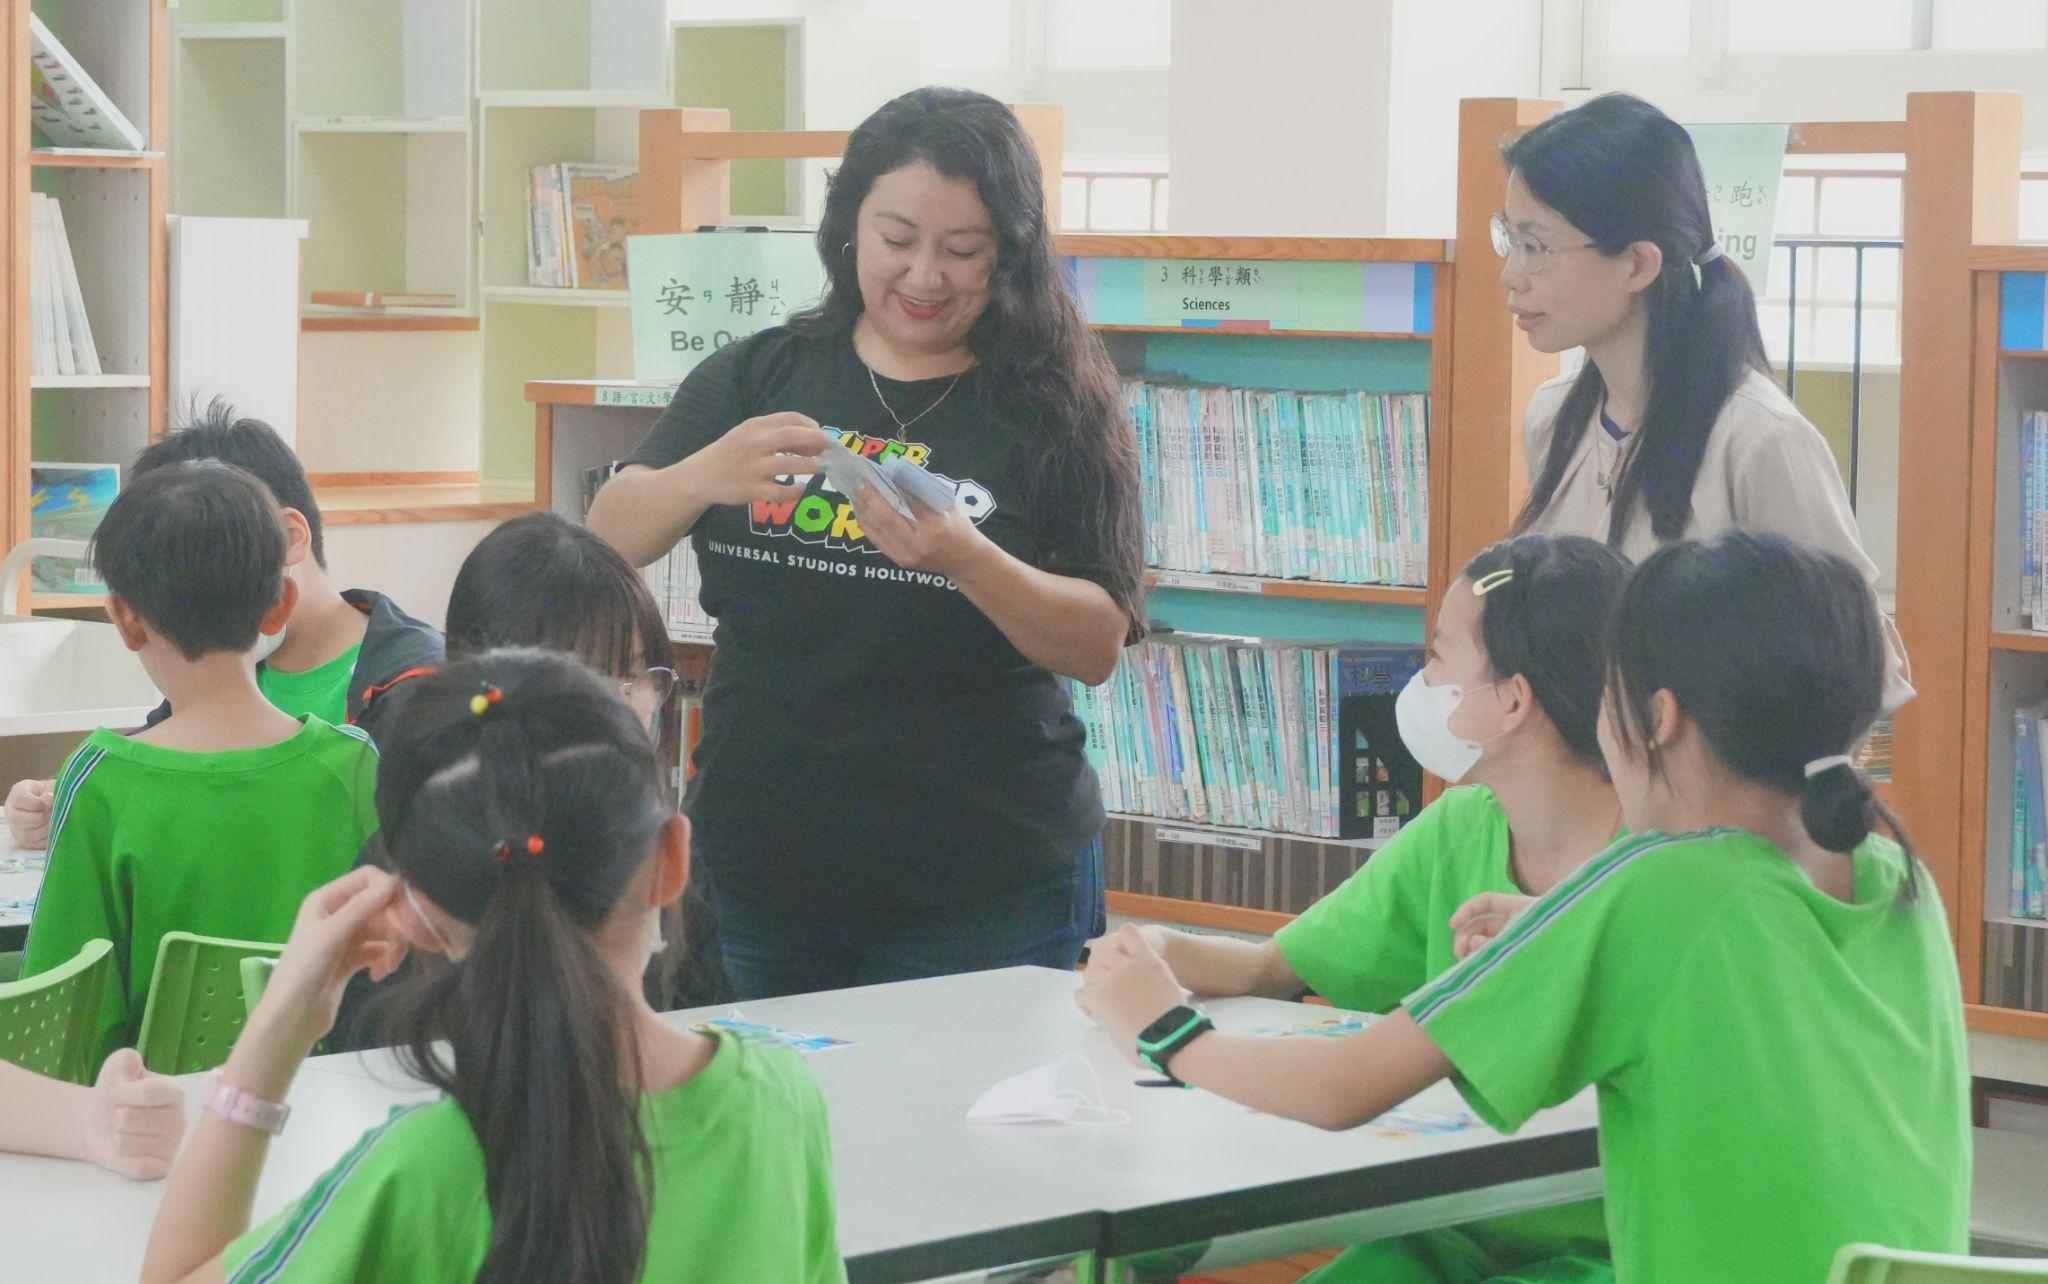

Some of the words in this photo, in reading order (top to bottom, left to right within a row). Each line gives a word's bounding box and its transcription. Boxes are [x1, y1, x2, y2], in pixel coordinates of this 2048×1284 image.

[1717, 229, 1757, 260] ing
[1160, 265, 1169, 283] 3
[1181, 265, 1252, 287] 科學類
[655, 276, 765, 316] 安靜
[1182, 297, 1231, 311] Sciences
[670, 330, 705, 351] Be
[750, 494, 866, 546] WOR
[708, 540, 780, 564] UNIVERSAL
[787, 554, 857, 577] STUDIOS
[864, 565, 958, 591] HOLLYWOO
